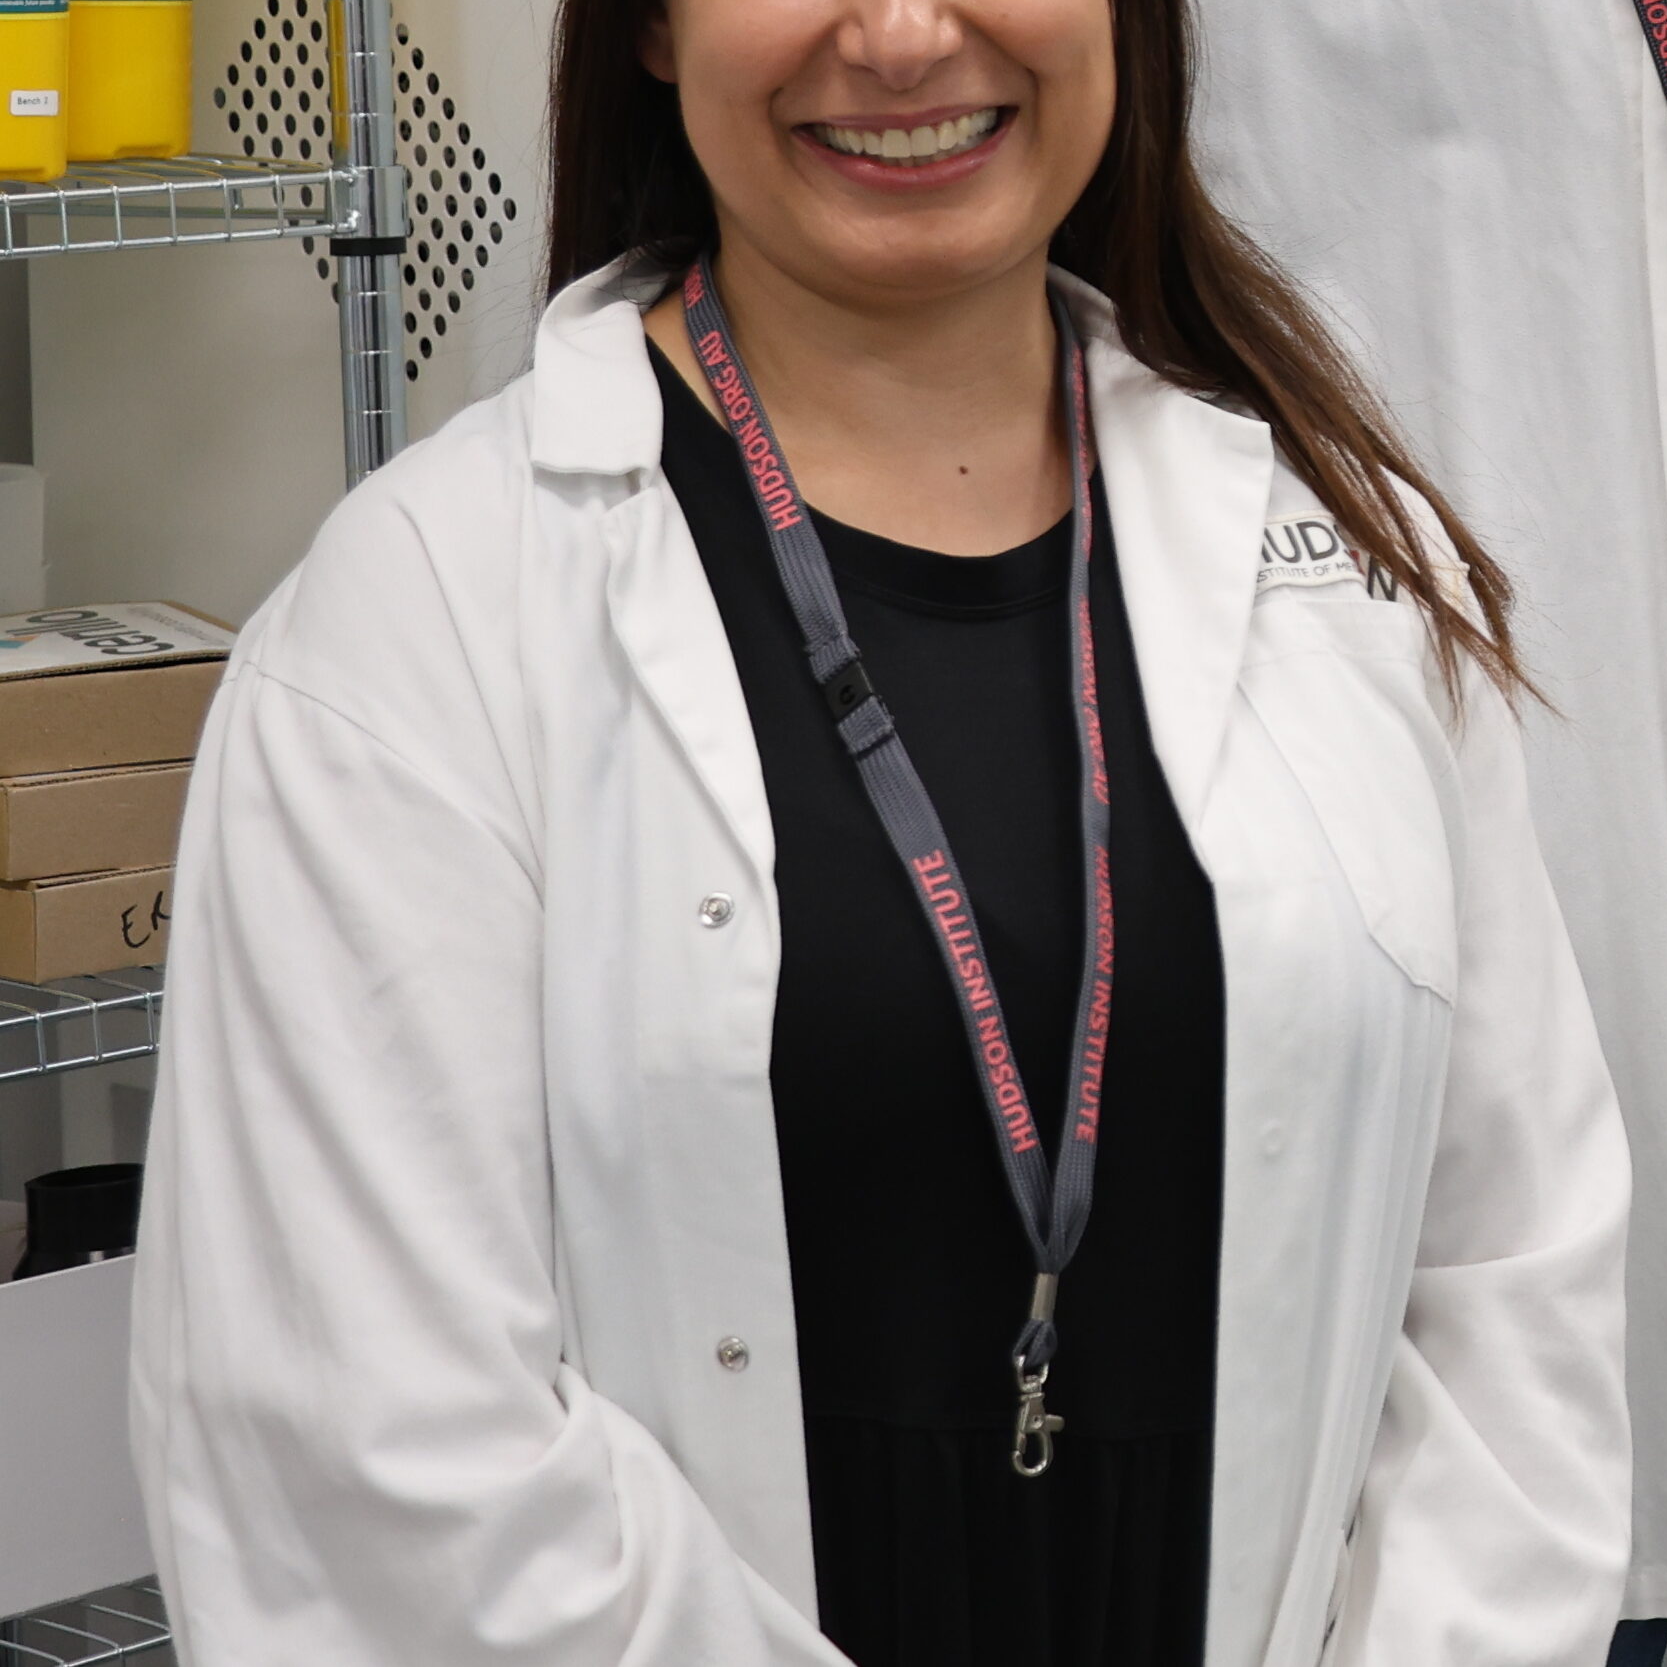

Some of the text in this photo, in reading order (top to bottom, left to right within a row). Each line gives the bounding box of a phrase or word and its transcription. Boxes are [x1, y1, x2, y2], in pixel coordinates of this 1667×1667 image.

[699, 330, 802, 531] HUDSON.ORG.AU
[1257, 563, 1309, 583] STITUTE
[1262, 521, 1398, 602] UDN
[912, 848, 1038, 1154] HUDSON INSTITUTE
[1075, 980, 1112, 1145] INSTITUTE
